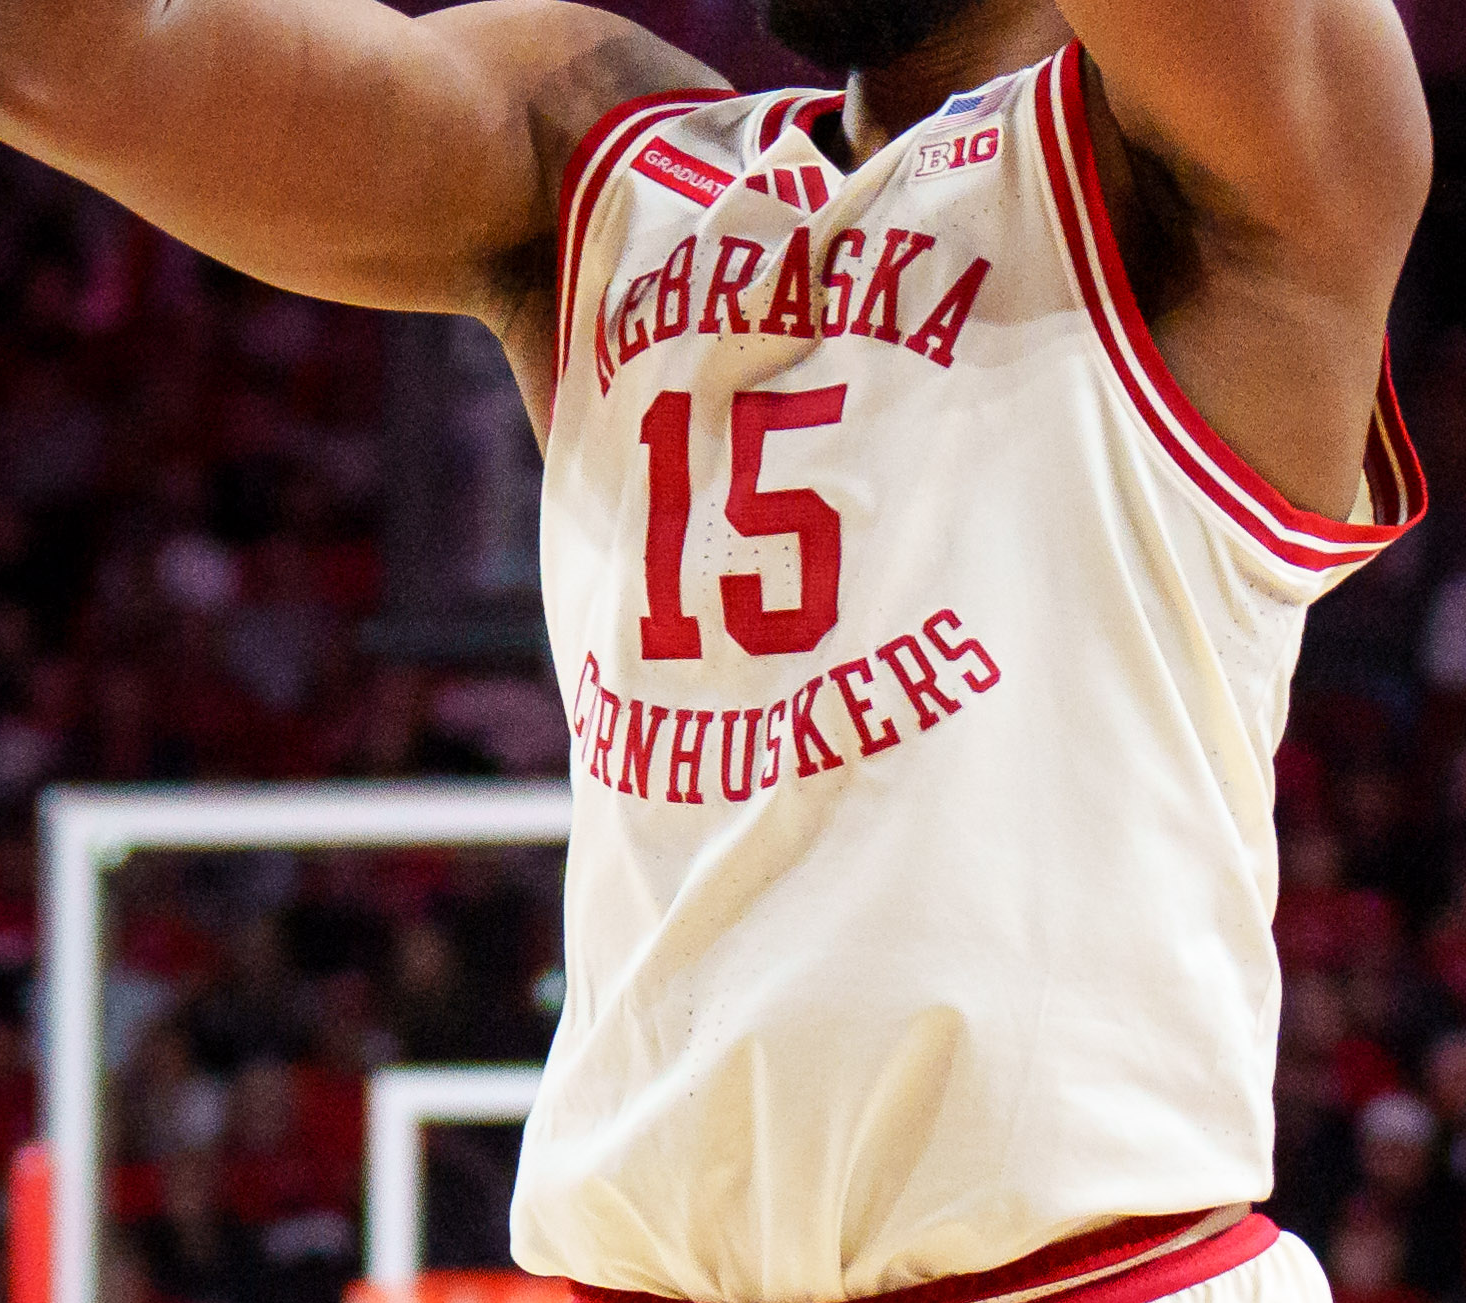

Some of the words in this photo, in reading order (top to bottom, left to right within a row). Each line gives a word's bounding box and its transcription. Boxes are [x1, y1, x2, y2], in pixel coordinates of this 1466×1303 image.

[644, 150, 727, 199] GRADUAT
[639, 383, 847, 661] 15
[574, 609, 1002, 804] CRNHUSKERS
